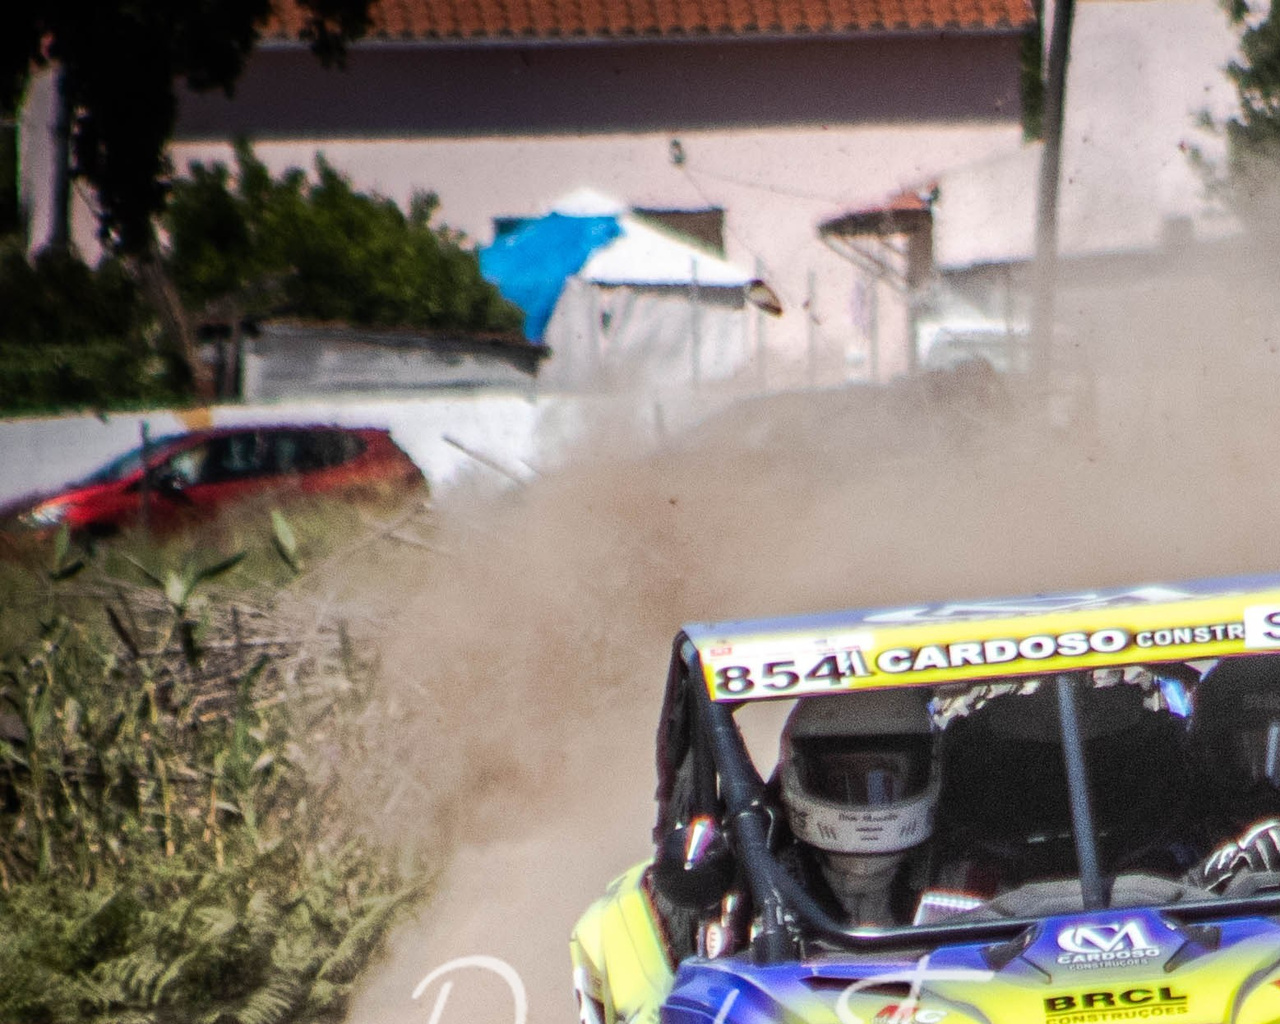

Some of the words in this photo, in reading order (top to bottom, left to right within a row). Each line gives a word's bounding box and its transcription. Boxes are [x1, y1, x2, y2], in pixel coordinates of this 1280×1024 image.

[876, 628, 1129, 674] CARDOSO
[714, 653, 846, 696] 854
[1056, 947, 1161, 966] CARDOSO
[1044, 986, 1188, 1014] BRCL
